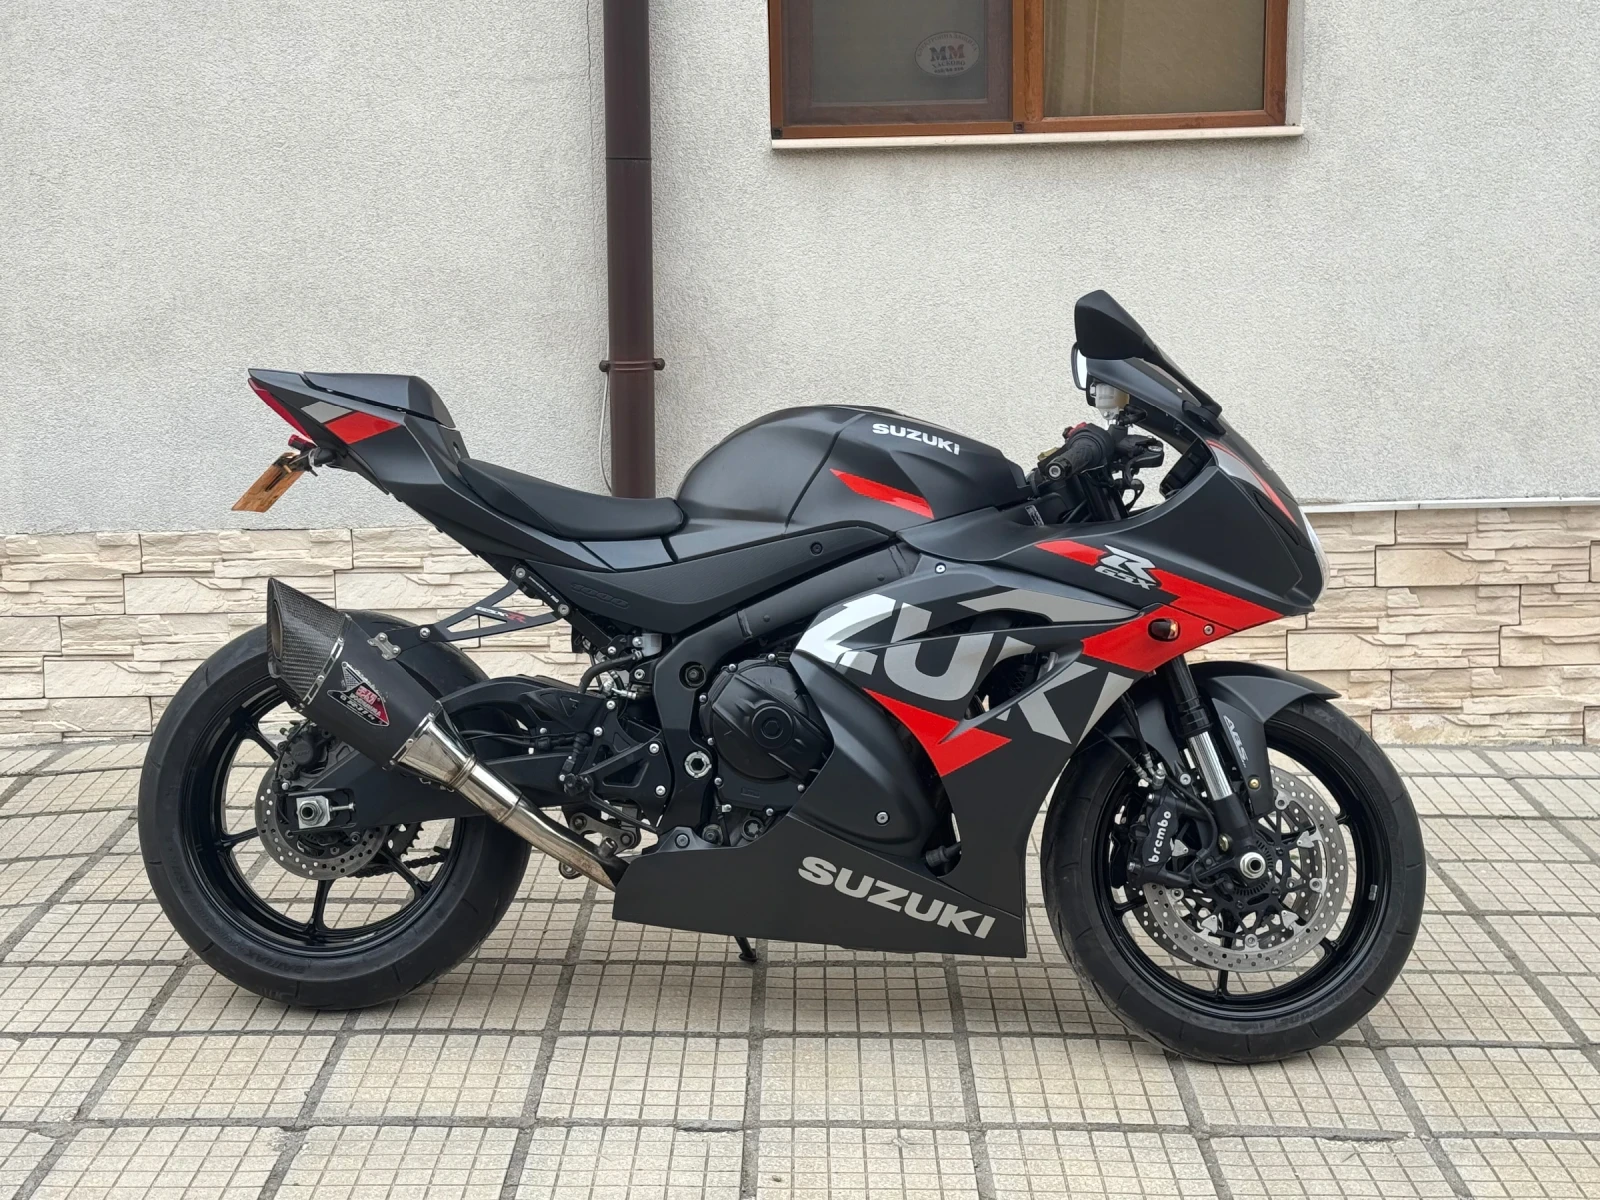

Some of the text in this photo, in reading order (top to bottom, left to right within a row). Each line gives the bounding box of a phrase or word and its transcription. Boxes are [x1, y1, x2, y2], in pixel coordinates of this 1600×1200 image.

[872, 423, 960, 455] SUZUKI
[1148, 810, 1172, 863] brembo
[798, 856, 996, 939] SUZUKI
